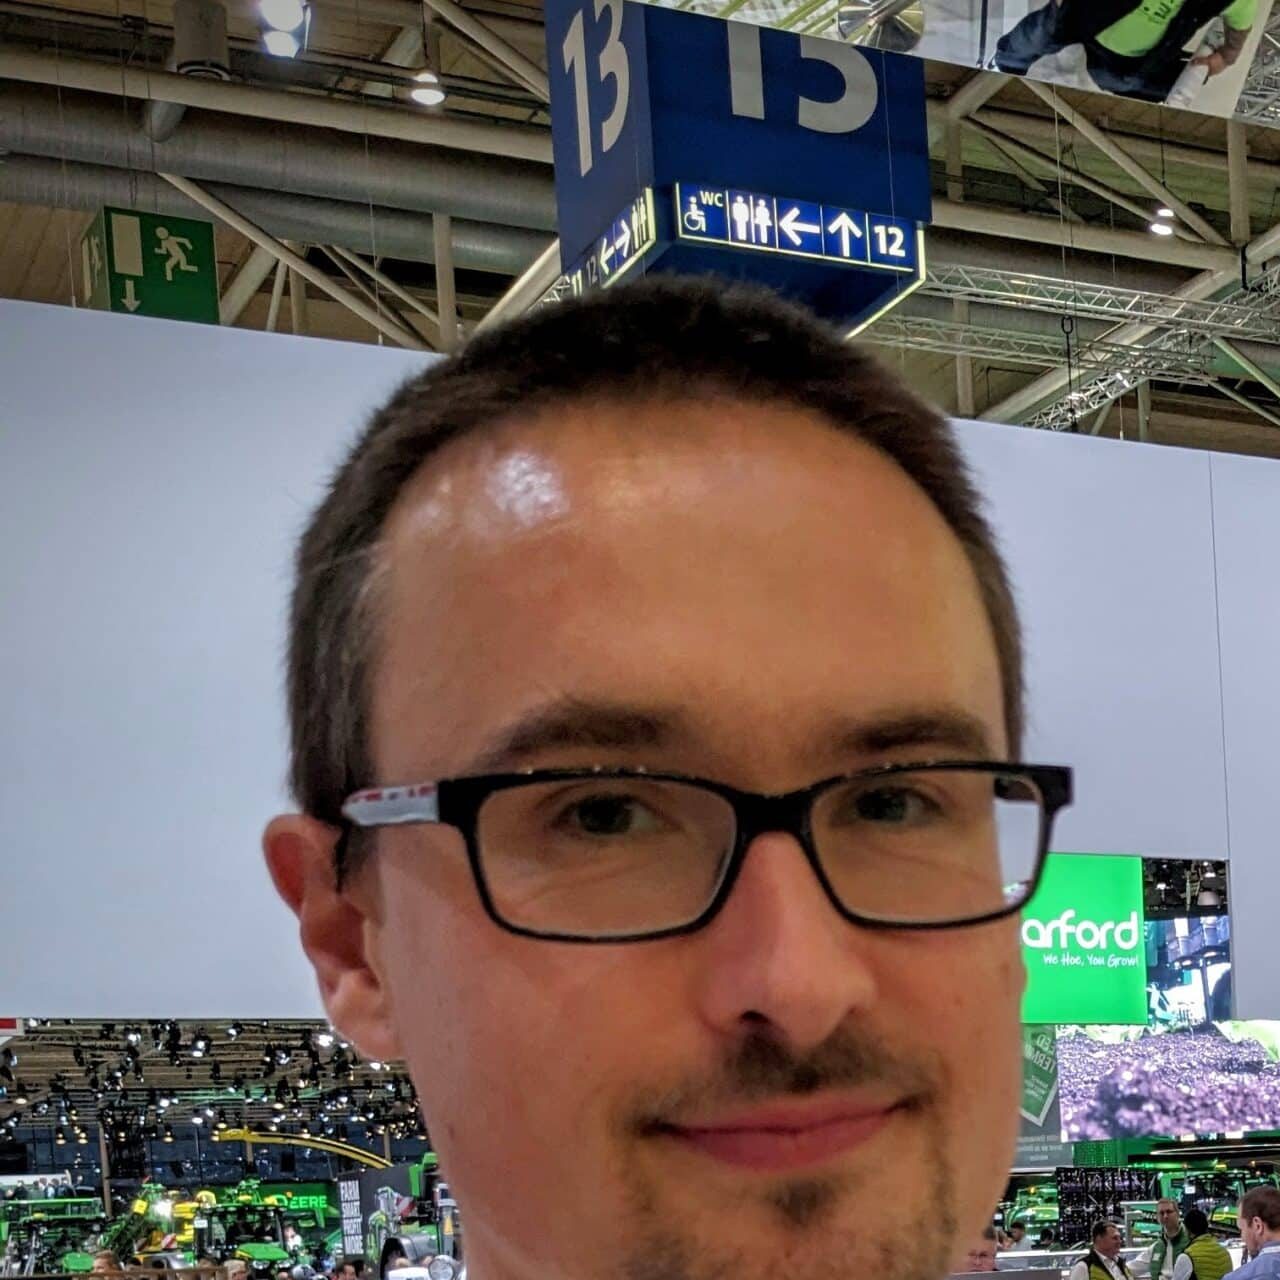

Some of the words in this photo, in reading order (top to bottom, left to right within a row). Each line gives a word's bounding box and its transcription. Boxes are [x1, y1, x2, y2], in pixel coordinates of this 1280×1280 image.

[563, 0, 630, 177] 13
[700, 190, 723, 208] WC
[873, 225, 906, 257] 12
[1021, 908, 1139, 951] arford
